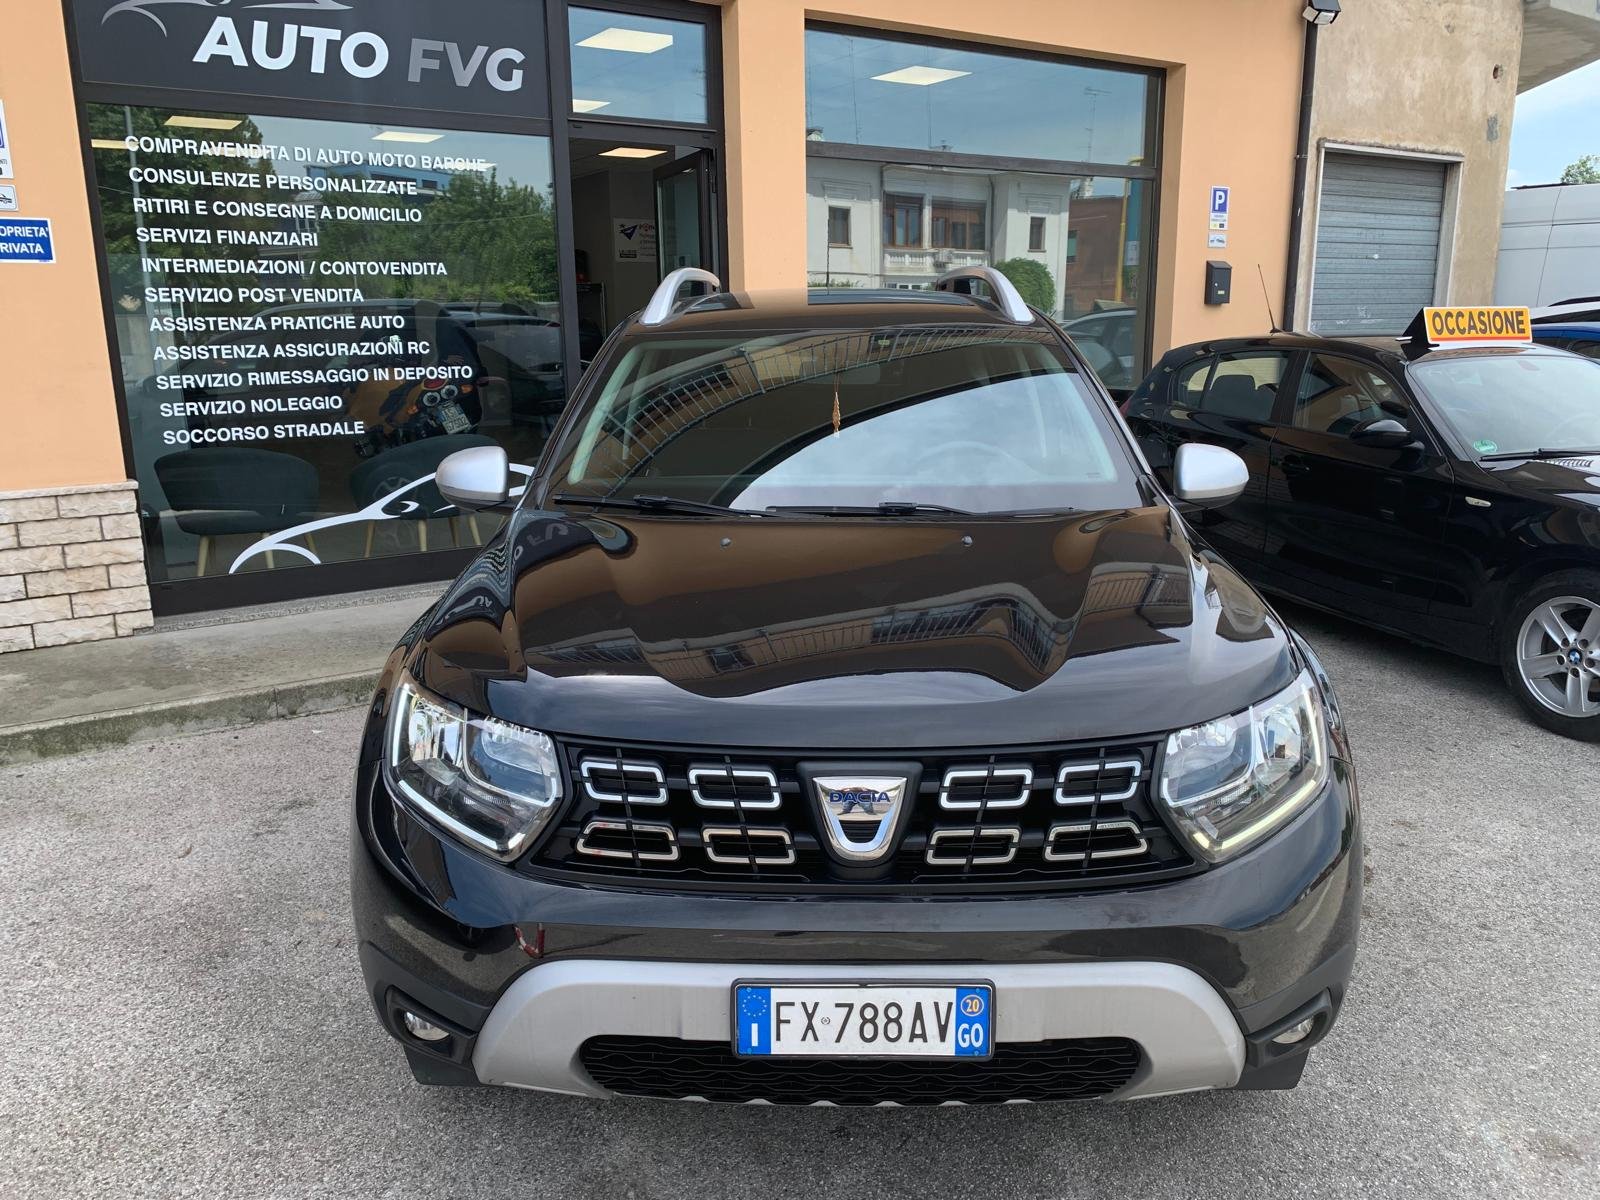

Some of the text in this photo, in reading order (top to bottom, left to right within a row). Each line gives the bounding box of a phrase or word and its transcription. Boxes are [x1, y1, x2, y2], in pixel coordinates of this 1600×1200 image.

[192, 16, 526, 92] AUTO FVG
[125, 135, 487, 172] COMPRAVENDITA DI AUTO MOTO BARCHE
[128, 167, 418, 196] CONSULENZE PERSONALIZZATE
[133, 197, 422, 223] RITIRI E CONSEGNE A DOMICILIO
[1214, 190, 1226, 211] P
[136, 227, 318, 247] SERVIZI FINANZIARI
[141, 257, 448, 276] INTERMEDIAZIONI / CONTOVENDITA
[144, 287, 364, 303] SERVIZIO POST VENDITA
[150, 315, 405, 332] ASSISTENZA PRATICHE AUTO
[1431, 310, 1526, 336] OCCASIONE
[153, 341, 430, 361] ASSISTENZA ASSICURAZIONI RC
[156, 365, 473, 390] SERVIZIO RIMESSAGGIO IN DEPOSITO
[160, 395, 343, 417] SERVIZIO NOLEGGIO
[163, 421, 365, 445] SOCCORSO STRADALE
[829, 792, 891, 803] DACIA
[965, 1000, 980, 1012] 20
[958, 1023, 984, 1047] GO
